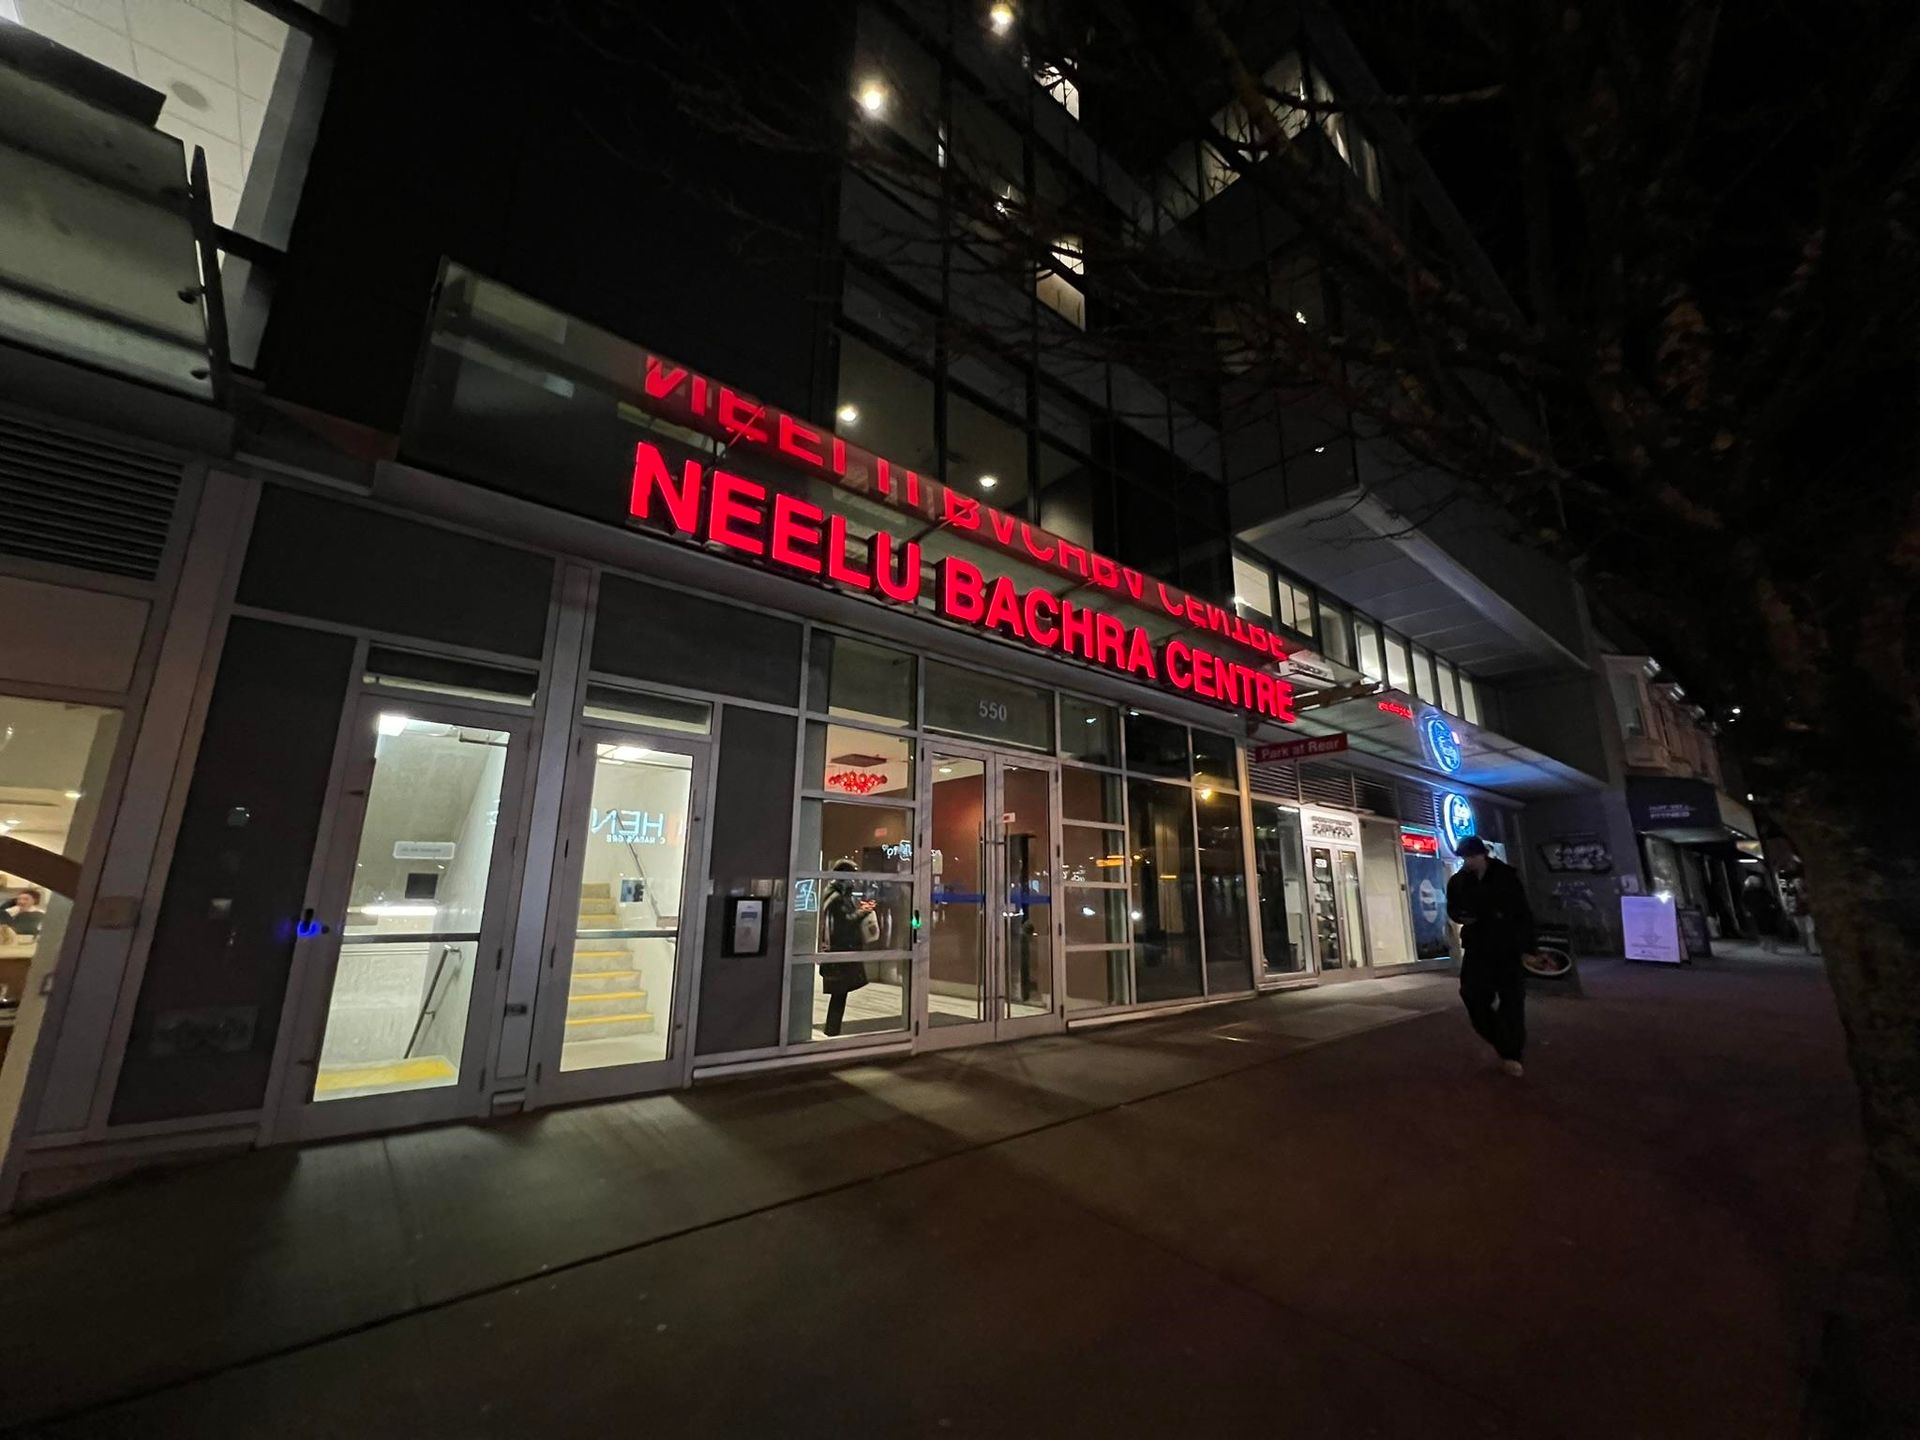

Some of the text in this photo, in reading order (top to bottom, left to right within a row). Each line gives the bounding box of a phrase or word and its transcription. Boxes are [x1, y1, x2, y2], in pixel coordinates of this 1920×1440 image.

[629, 440, 1297, 723] NEELU BACHRA CENTRE
[979, 700, 1007, 721] 550
[1261, 739, 1340, 759] Park at Rear
